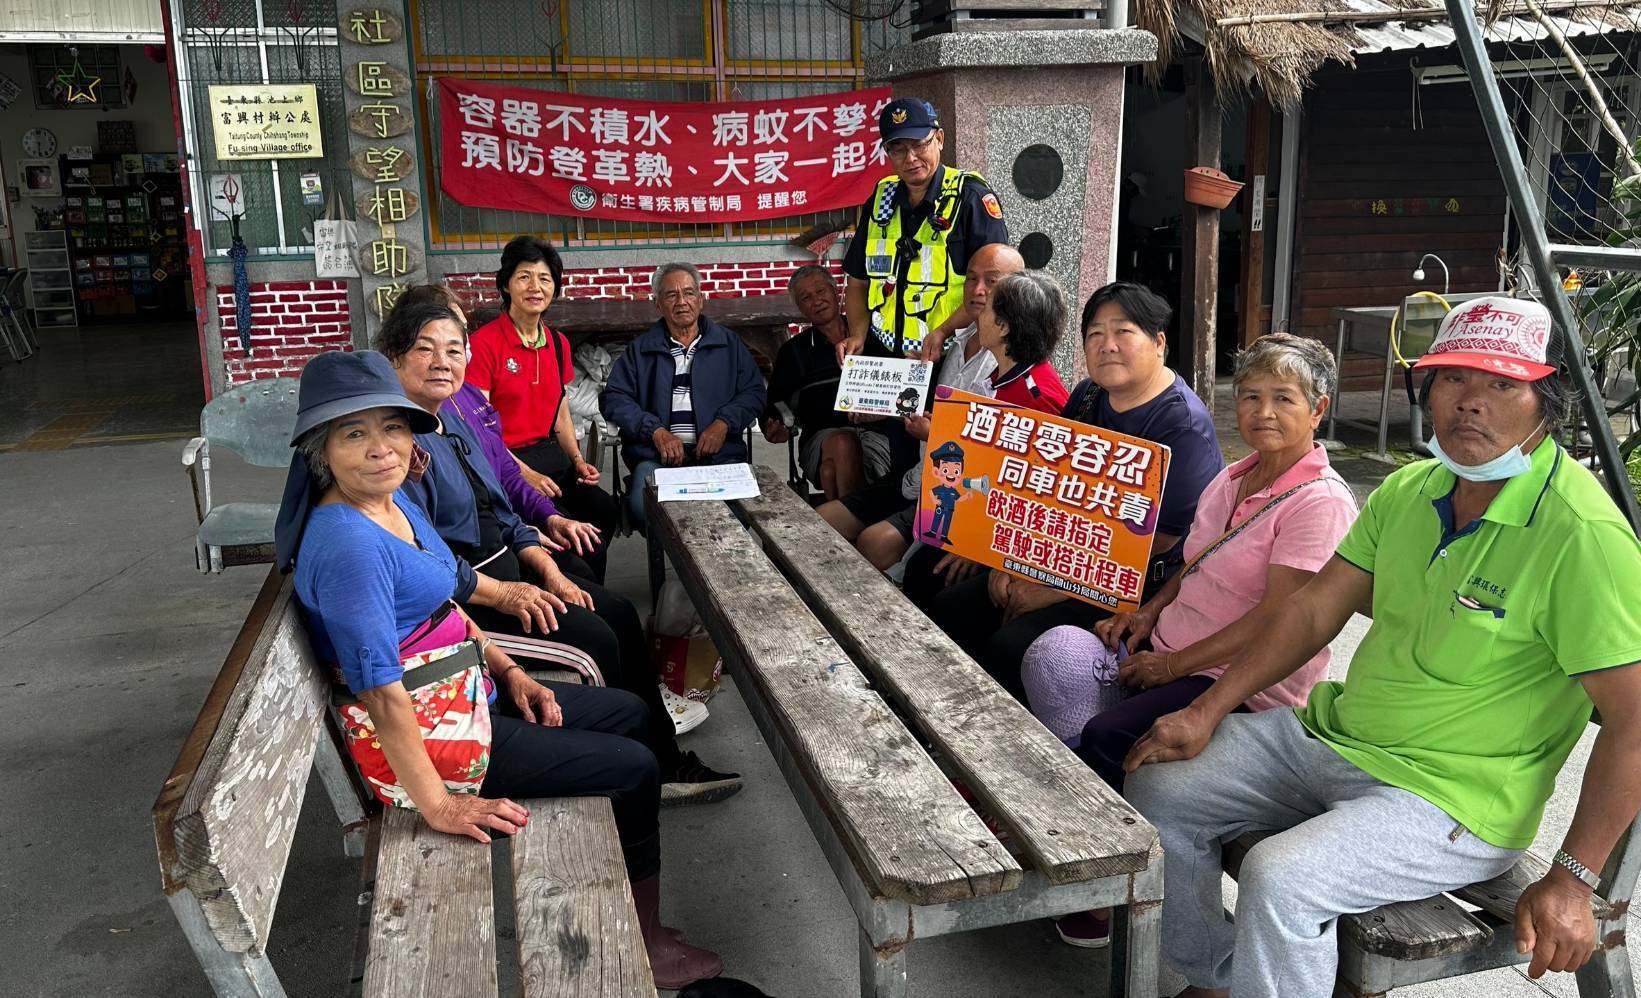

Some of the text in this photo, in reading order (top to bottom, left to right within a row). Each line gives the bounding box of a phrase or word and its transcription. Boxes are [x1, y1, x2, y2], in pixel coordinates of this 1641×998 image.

[220, 110, 313, 125] 富興村辦公處
[228, 144, 239, 153] Fu
[260, 143, 288, 152] Village
[290, 143, 313, 152] office
[602, 190, 807, 213] 衛生署疾病管制局 提醒您
[1455, 323, 1514, 339] Asenay
[848, 368, 903, 382] 打詐儀錶板
[960, 402, 1152, 486] 酒駕零容忍
[996, 455, 1153, 527] 同車也共責
[986, 488, 1113, 555] 飲酒後請指定
[991, 523, 1142, 598] 駕駛或搭計程車
[1003, 558, 1119, 608] 臺東縣警察局關山分局關心您
[1466, 574, 1507, 599] 興環保志
